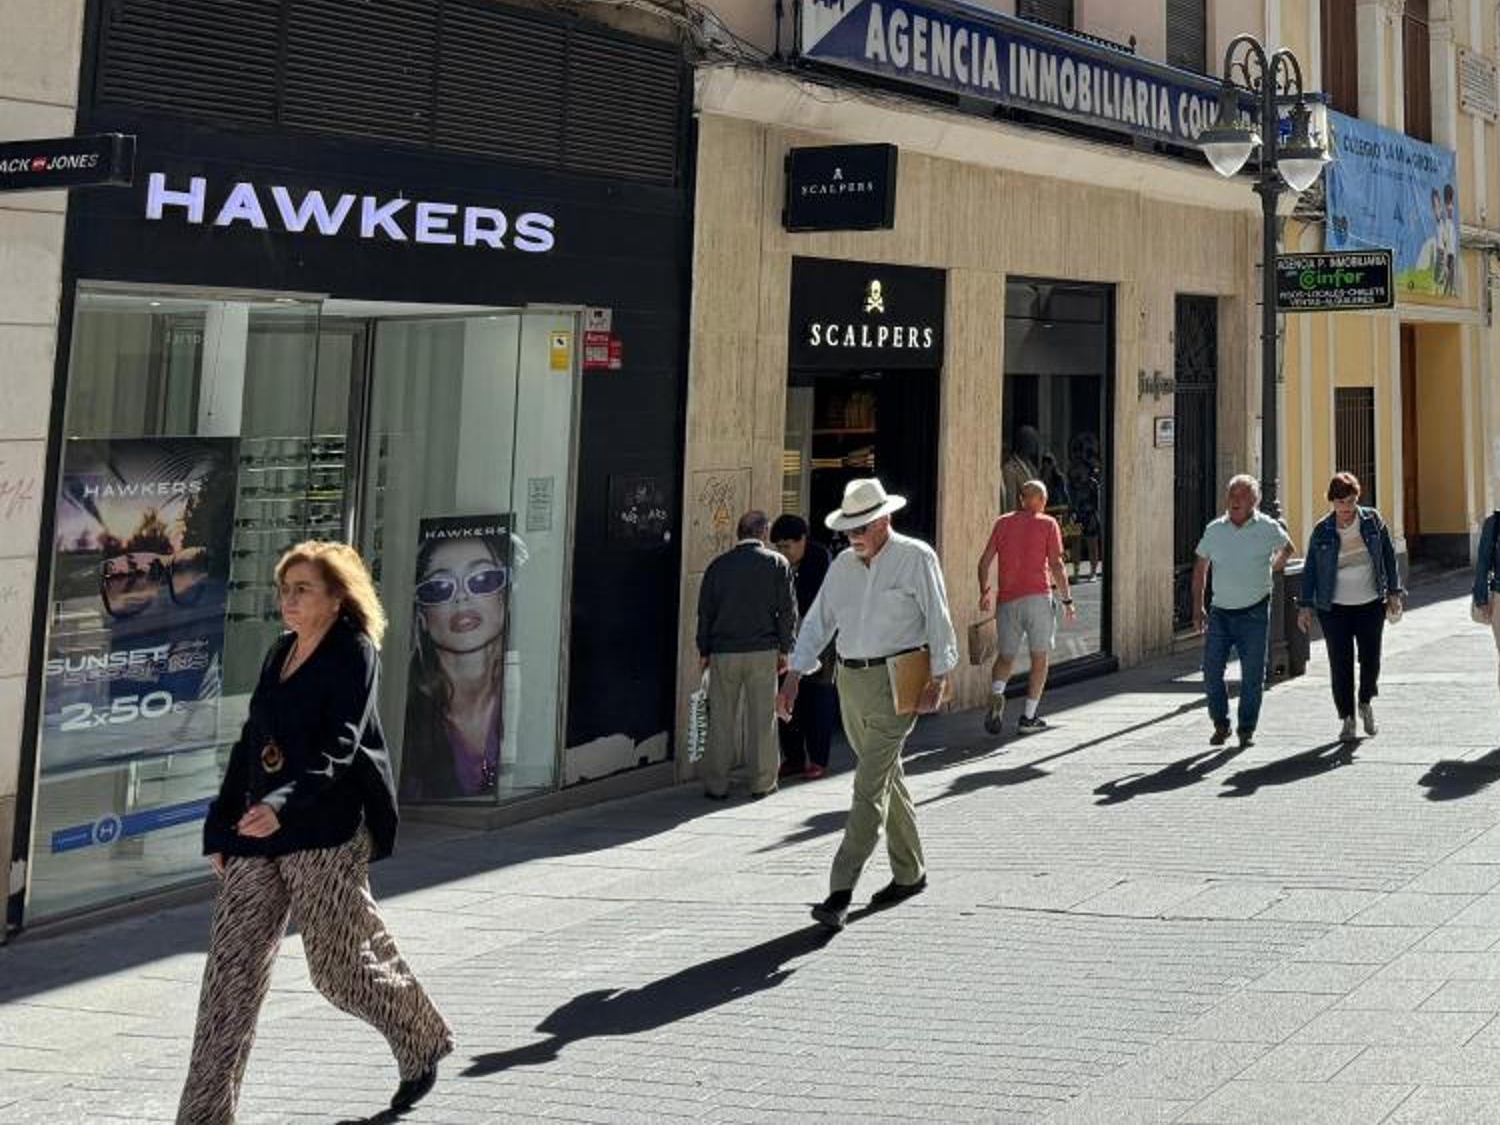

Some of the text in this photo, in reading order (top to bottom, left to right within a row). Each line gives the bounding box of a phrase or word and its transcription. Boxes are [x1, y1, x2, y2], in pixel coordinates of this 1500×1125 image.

[863, 3, 1000, 91] AGENCIA
[1008, 42, 1173, 133] INMOBILIARIA
[46, 154, 99, 170] JONES
[801, 181, 873, 195] SCALPERS
[145, 172, 556, 252] HAWKERS
[810, 323, 933, 358] SCALPERS
[83, 479, 203, 499] HAWKERS
[425, 525, 508, 540] HAWKERS
[47, 644, 169, 675] SUNSET
